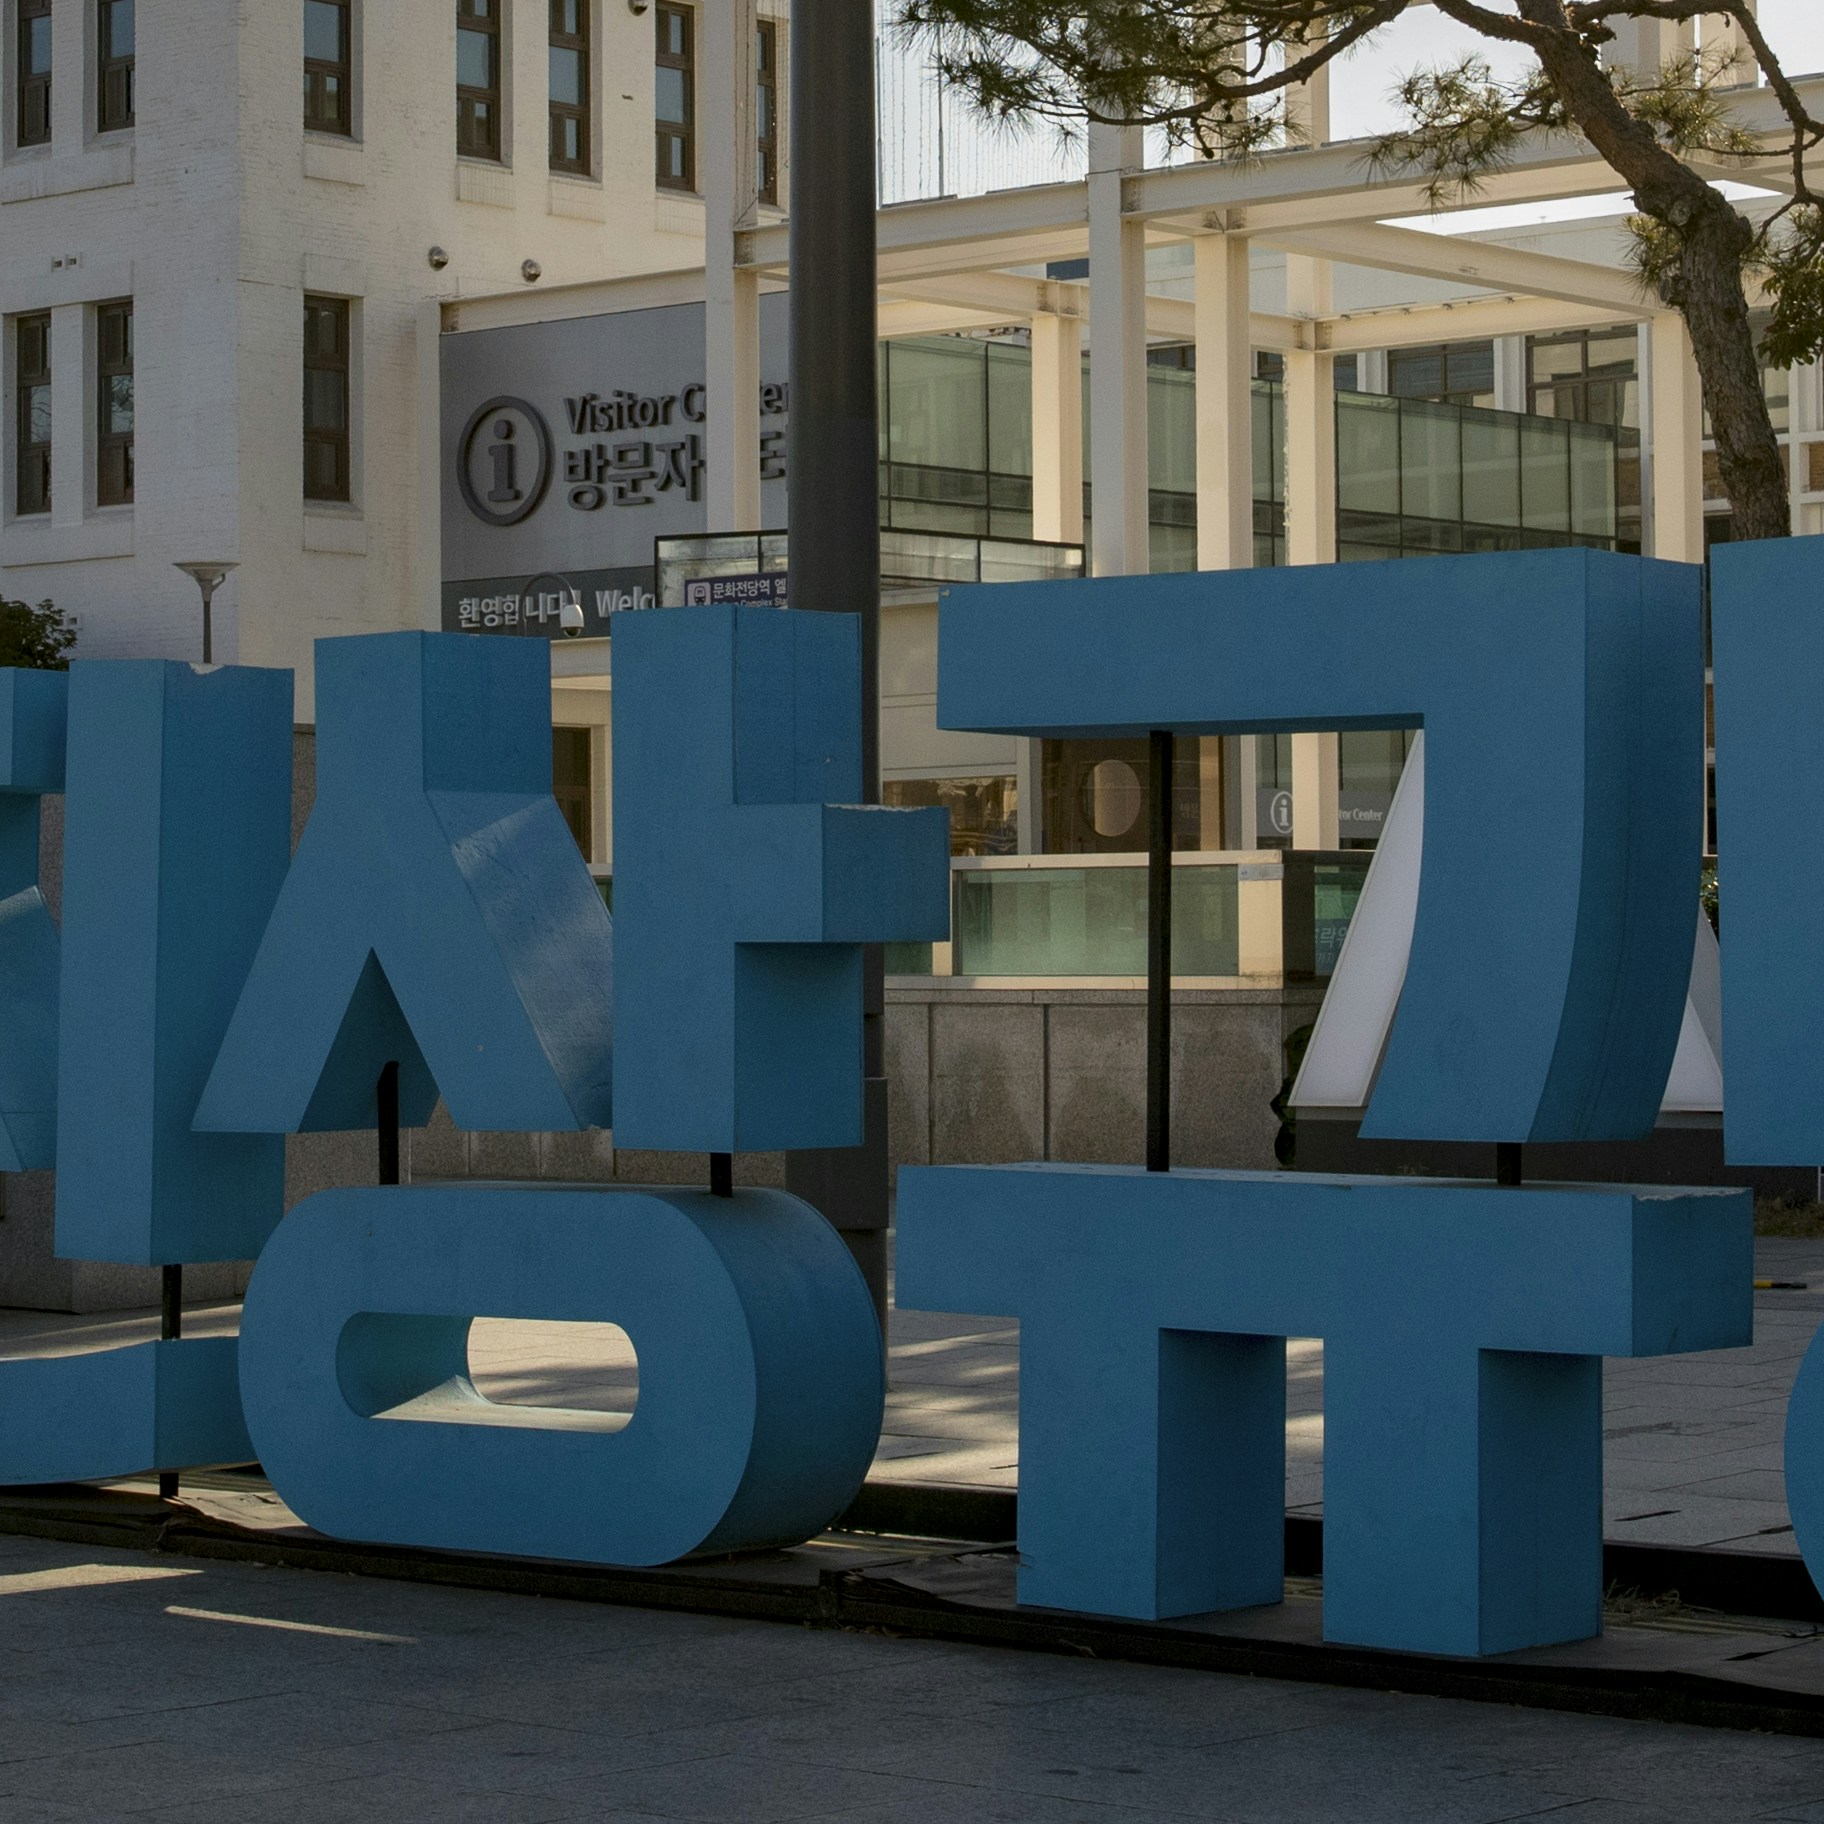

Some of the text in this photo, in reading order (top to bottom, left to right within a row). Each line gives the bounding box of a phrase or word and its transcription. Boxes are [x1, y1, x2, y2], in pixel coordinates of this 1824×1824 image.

[563, 389, 676, 436] Visitor
[563, 432, 789, 512] 방문자터
[712, 578, 771, 599] 문화전당역
[1350, 807, 1383, 823] Center
